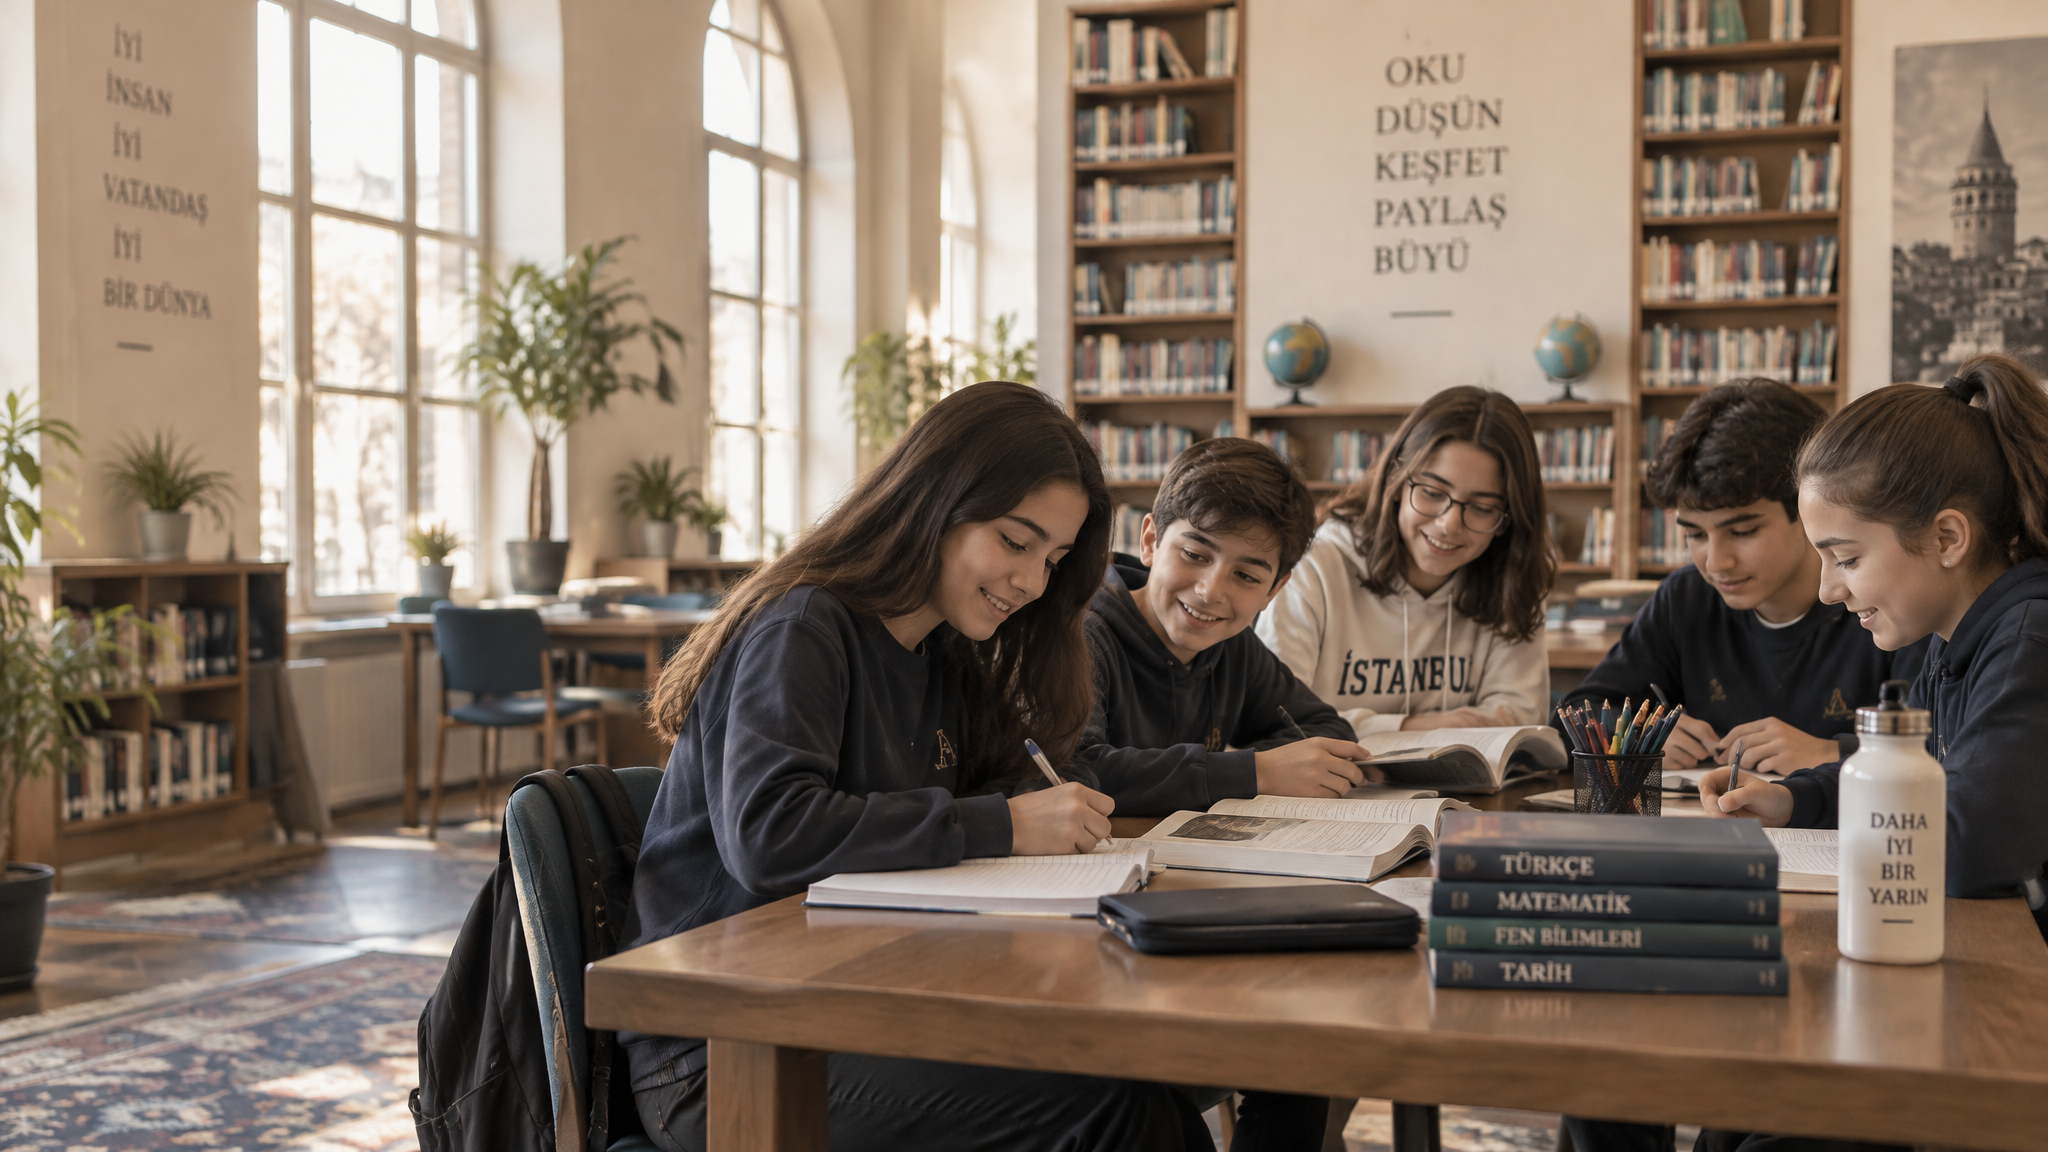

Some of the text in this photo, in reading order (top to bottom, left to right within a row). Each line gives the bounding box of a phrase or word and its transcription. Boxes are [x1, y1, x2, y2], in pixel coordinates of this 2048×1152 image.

[113, 22, 143, 64] İYİ
[1384, 52, 1466, 88] OKU
[106, 68, 173, 118] İNSAN
[1374, 94, 1503, 140] DÜŞÜN
[112, 121, 142, 162] İYİ
[1374, 145, 1511, 186] KEŞFET
[102, 172, 210, 228] VATANDAŞ
[1373, 193, 1508, 231] PAYLAŞ
[113, 223, 142, 263] İYİ
[1373, 236, 1470, 275] BÜYÜ
[103, 275, 213, 321] BİR DÜNYA
[1337, 649, 1476, 696] İSTANBUL
[1870, 812, 1928, 830] DAHA
[1886, 835, 1913, 856] İYİ
[1499, 851, 1595, 881] TÜRKÇE
[1881, 861, 1916, 881] BİR
[1497, 890, 1632, 915] MATEMATİK
[1868, 887, 1929, 905] YARIN
[1494, 926, 1536, 946] FEN
[1499, 959, 1573, 984] TARİH
